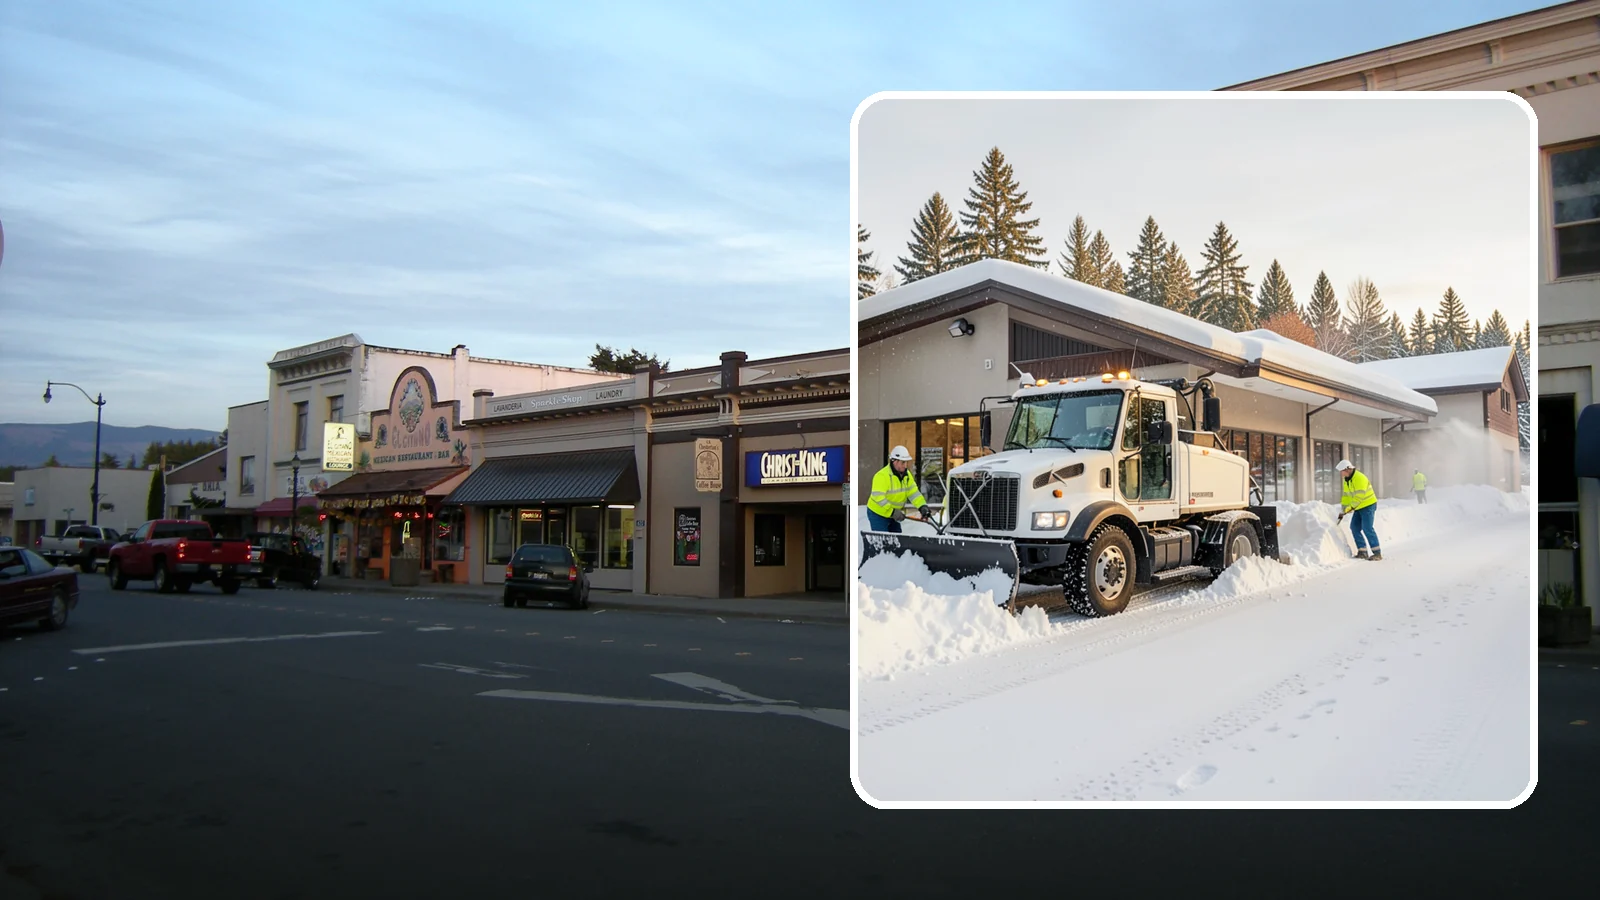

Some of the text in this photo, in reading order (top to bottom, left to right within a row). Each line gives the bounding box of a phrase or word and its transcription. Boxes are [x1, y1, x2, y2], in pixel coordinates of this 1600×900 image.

[595, 388, 624, 400] LAUNDRY
[493, 402, 523, 413] LAVANDERIA
[530, 394, 583, 409] Sparkle Shop
[373, 454, 396, 464] MEXICAN
[397, 451, 433, 463] RESTAURANT
[437, 450, 450, 459] BAR
[760, 450, 827, 478] CHRIST KING
[696, 481, 722, 489] Coffee House
